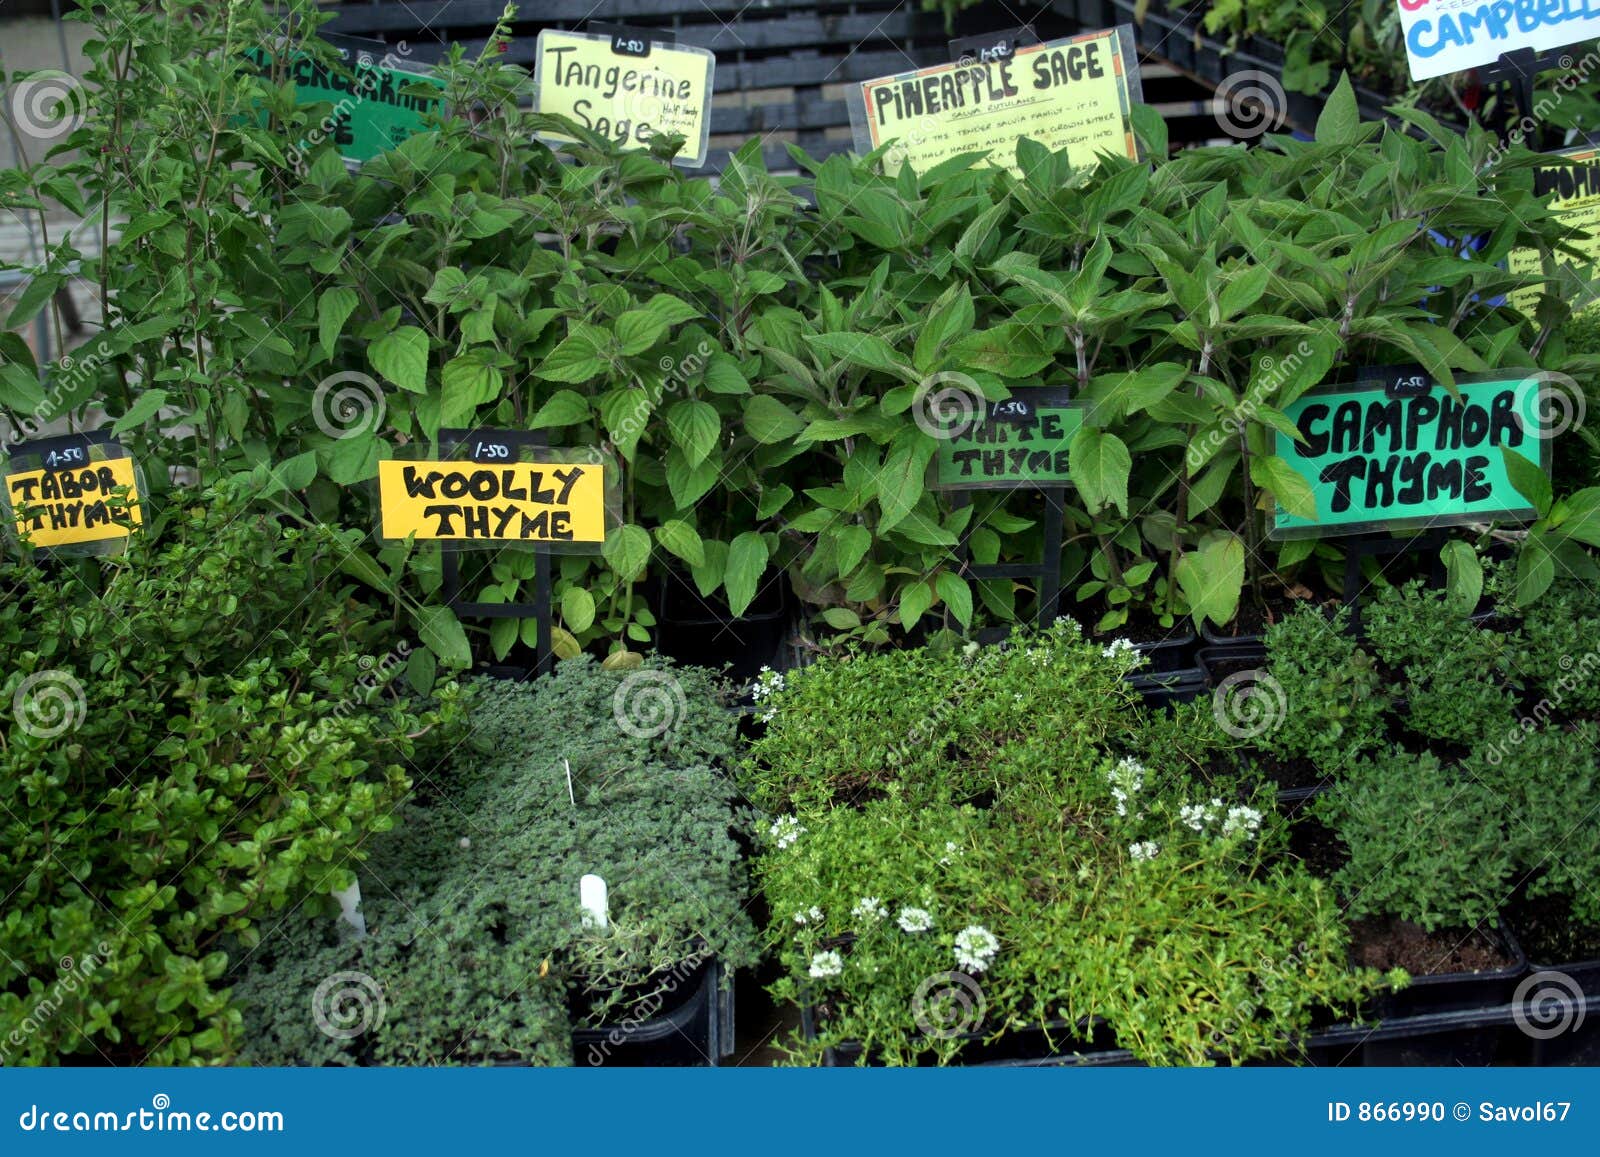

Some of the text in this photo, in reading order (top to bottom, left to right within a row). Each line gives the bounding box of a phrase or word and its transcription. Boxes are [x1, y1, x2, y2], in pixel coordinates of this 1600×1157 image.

[616, 38, 643, 53] 1-50
[1033, 42, 1104, 90] SAGE
[920, 149, 945, 160] HALF
[985, 136, 1005, 146] AND
[1049, 118, 1084, 132] GROWN
[1395, 375, 1425, 389] 1-50
[992, 401, 1028, 416] 1-50
[1294, 390, 1524, 458] CAMPHOR
[46, 447, 83, 467] 1-50
[474, 442, 510, 459] 1-50
[951, 448, 1070, 476] THYME
[12, 467, 117, 502] TABOR
[402, 465, 586, 505] WOOLLY
[1319, 452, 1493, 513] THYME
[23, 500, 131, 531] THYME
[423, 504, 574, 541] THYME
